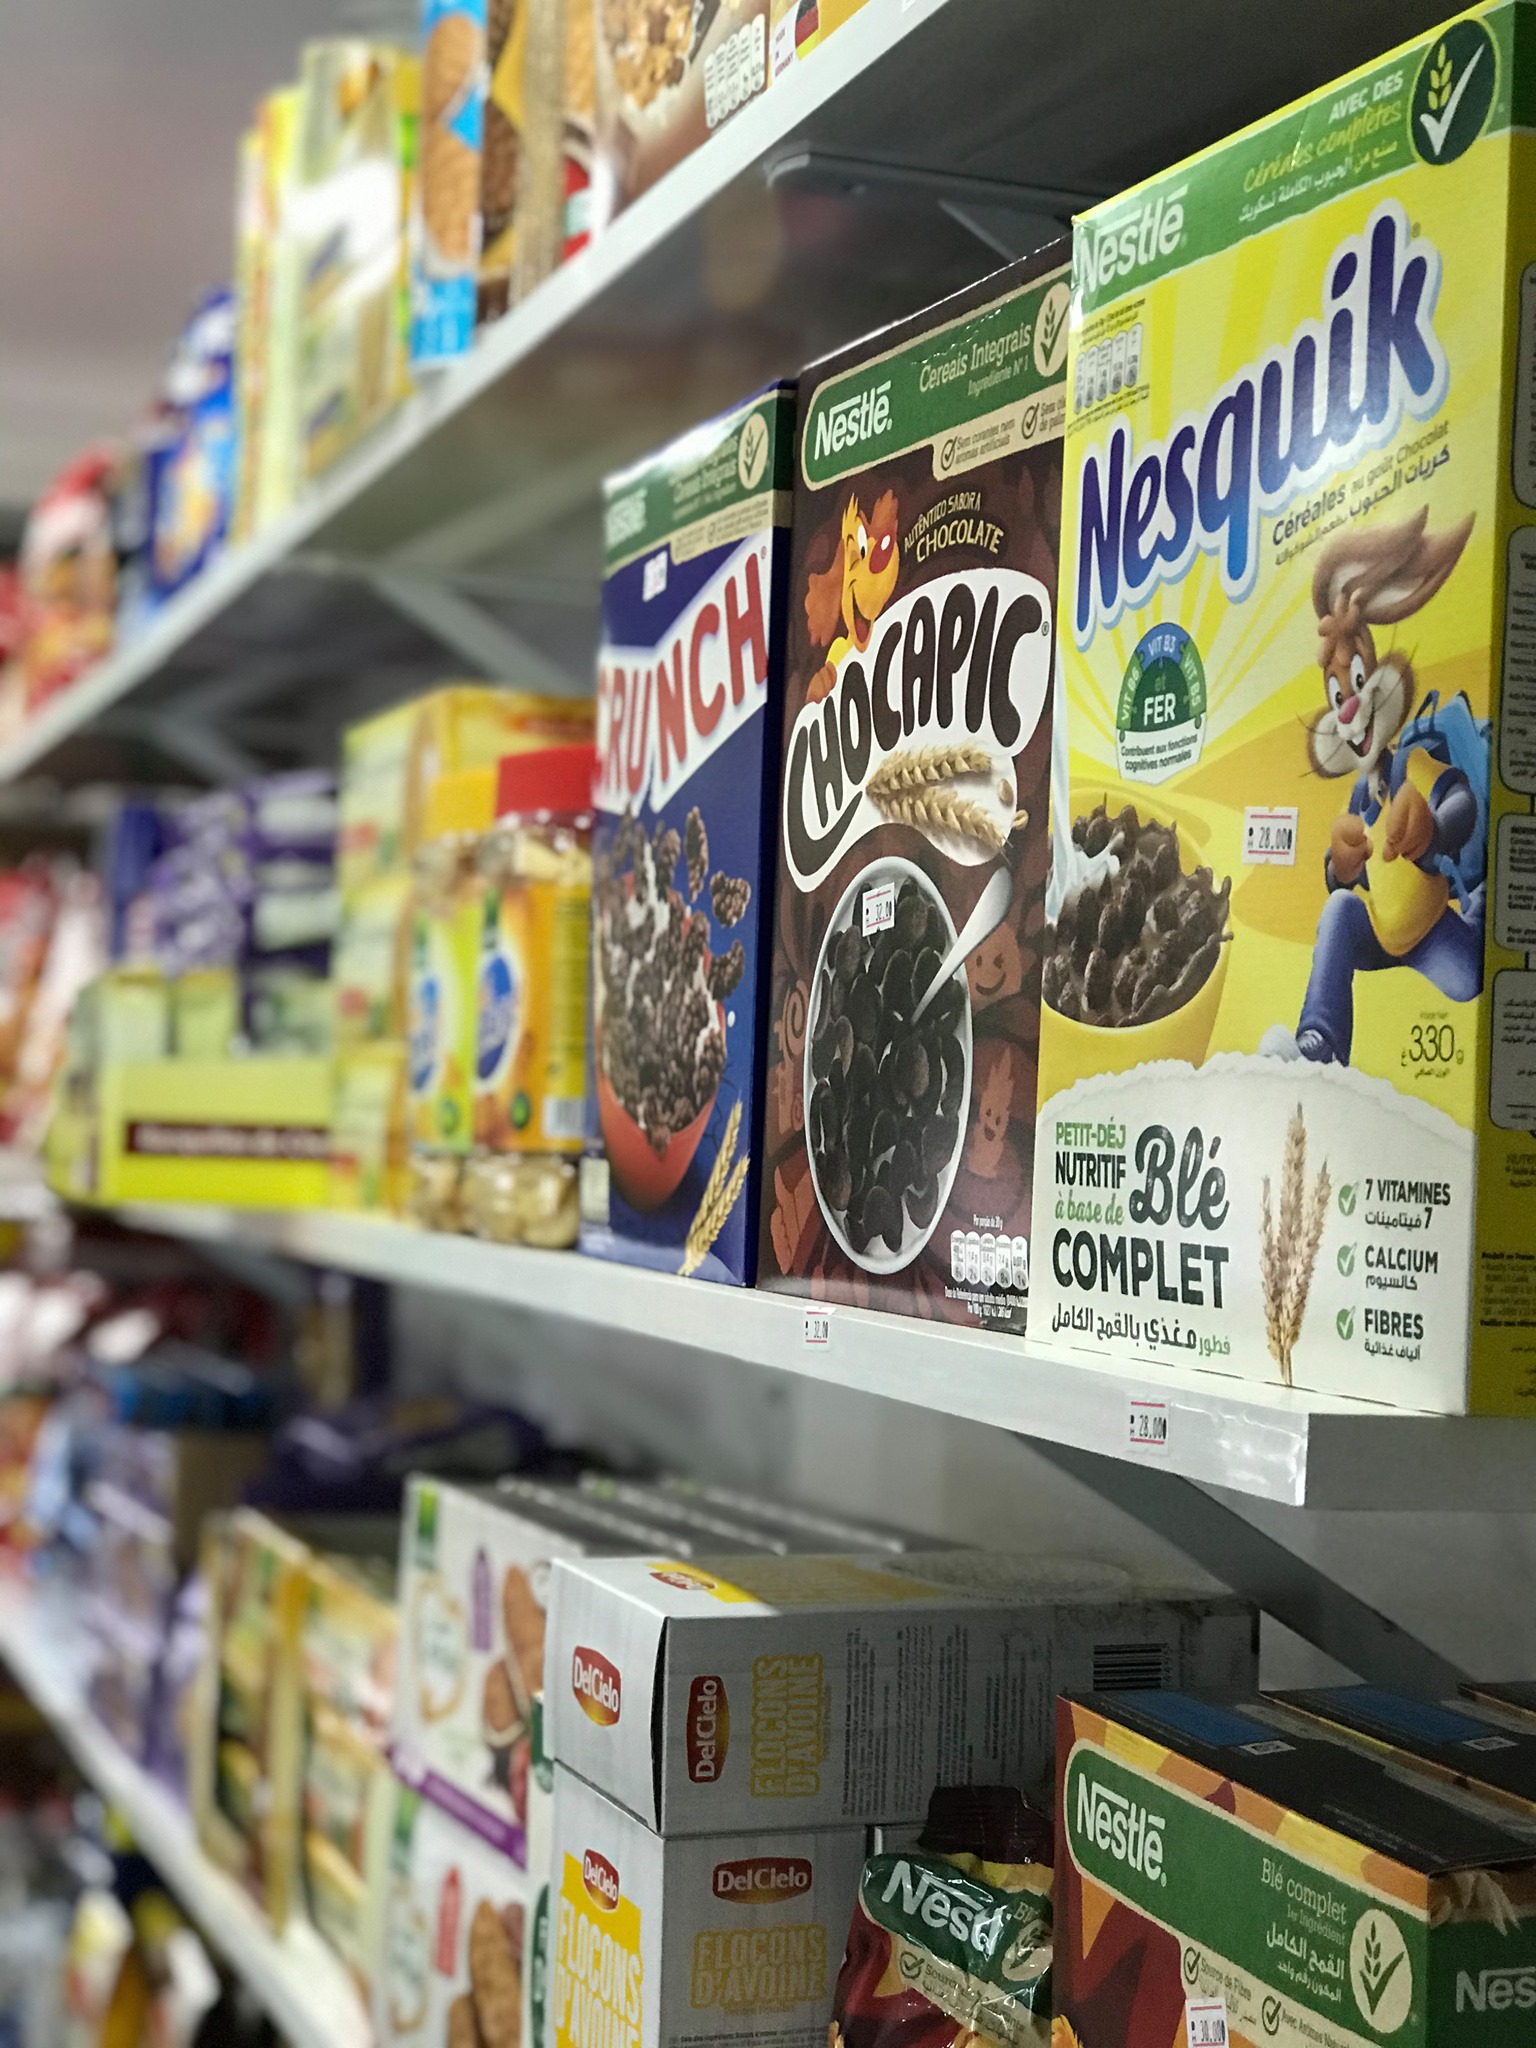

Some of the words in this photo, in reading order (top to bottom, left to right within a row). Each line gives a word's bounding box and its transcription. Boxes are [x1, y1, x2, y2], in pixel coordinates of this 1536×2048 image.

[1328, 88, 1369, 124] AVEC
[1373, 70, 1404, 102] DES
[1078, 184, 1189, 293] Nestlé
[919, 350, 969, 393] Cereais
[970, 322, 1032, 367] Integrais
[813, 380, 893, 461] Nestlé
[1076, 213, 1436, 633] Nesquik
[1272, 484, 1347, 546] Céréales
[916, 518, 1005, 563] CHOCOLATE
[787, 582, 1043, 877] CHOCAPIC
[1143, 692, 1177, 727] FER
[1408, 1024, 1455, 1062] 330
[1055, 1115, 1126, 1150] PETIT-DÉJ
[1055, 1150, 1127, 1189] NUTRITIF
[1129, 1124, 1231, 1232] Blé
[1055, 1190, 1065, 1220] à
[1067, 1188, 1103, 1225] base
[1104, 1193, 1126, 1226] de
[1365, 1178, 1374, 1201] 7
[1377, 1178, 1452, 1207] VITAMINES
[1364, 1210, 1422, 1232] فيتامينات
[1423, 1206, 1433, 1230] 7
[1053, 1227, 1230, 1310] COMPLET
[1364, 1244, 1439, 1275] CALCIUM
[1365, 1274, 1418, 1292] كالسيوم
[1052, 1302, 1094, 1333] الكامل
[1096, 1311, 1140, 1348] بالقمح
[1144, 1317, 1197, 1351] مغذي
[1364, 1307, 1424, 1341] FIBRES
[1198, 1334, 1231, 1358] فطور
[573, 1655, 619, 1713] DelCielo
[695, 1679, 719, 1778] DelCielo
[754, 1660, 788, 1794] FLOCONS
[785, 1657, 820, 1794] D'AVOINE
[1076, 1772, 1168, 1888] Nestlé
[583, 1855, 619, 1902] DelCielo
[716, 1866, 809, 1893] DelCielo
[1261, 1857, 1284, 1892] Blé
[1287, 1878, 1347, 1926] complet
[559, 1896, 641, 2026] FLOCONS
[697, 1927, 824, 1971] FLOCONS
[1266, 1921, 1308, 1960] الكامل
[694, 1962, 824, 2005] D'AVOINE
[1456, 1965, 1536, 2013] Nes
